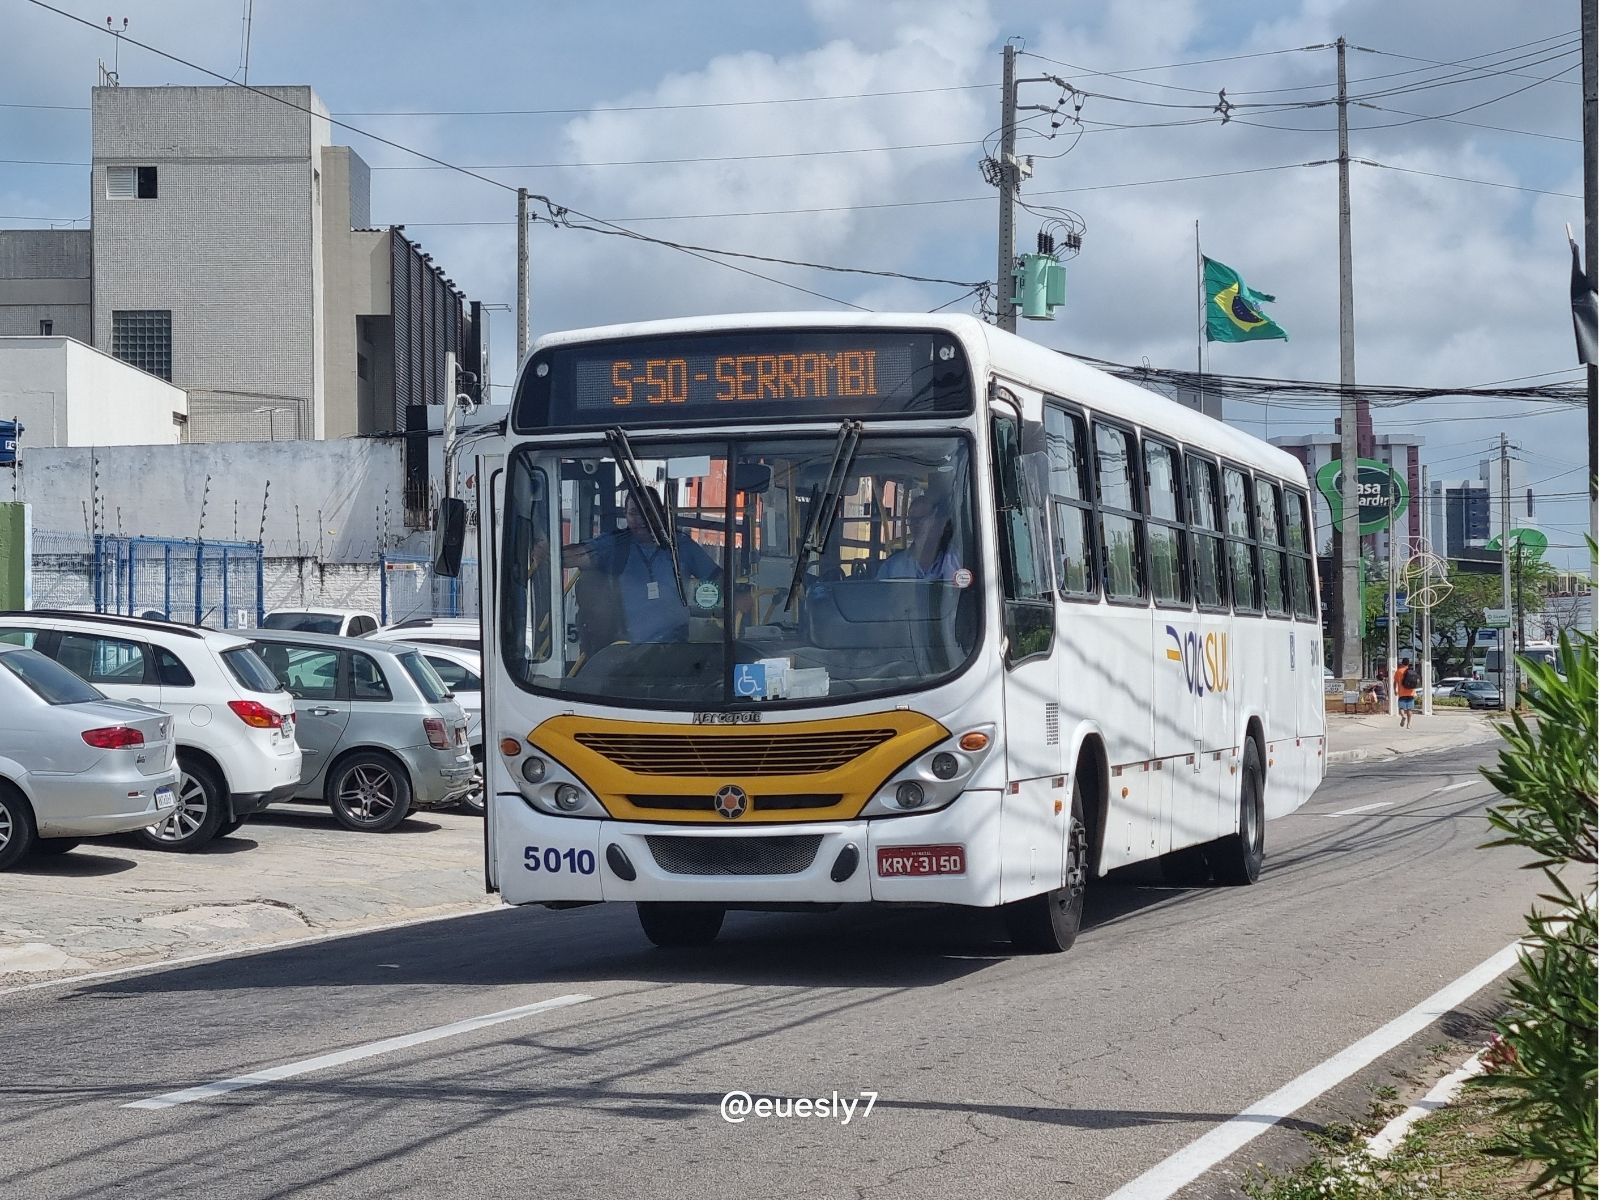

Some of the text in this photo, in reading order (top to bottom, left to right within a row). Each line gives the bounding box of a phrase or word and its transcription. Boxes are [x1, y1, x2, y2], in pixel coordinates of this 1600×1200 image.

[612, 359, 688, 405] S-50
[714, 351, 877, 400] SERRAMBI
[1357, 483, 1381, 495] asa
[693, 711, 762, 725] Marcopolo
[524, 846, 596, 875] 5010
